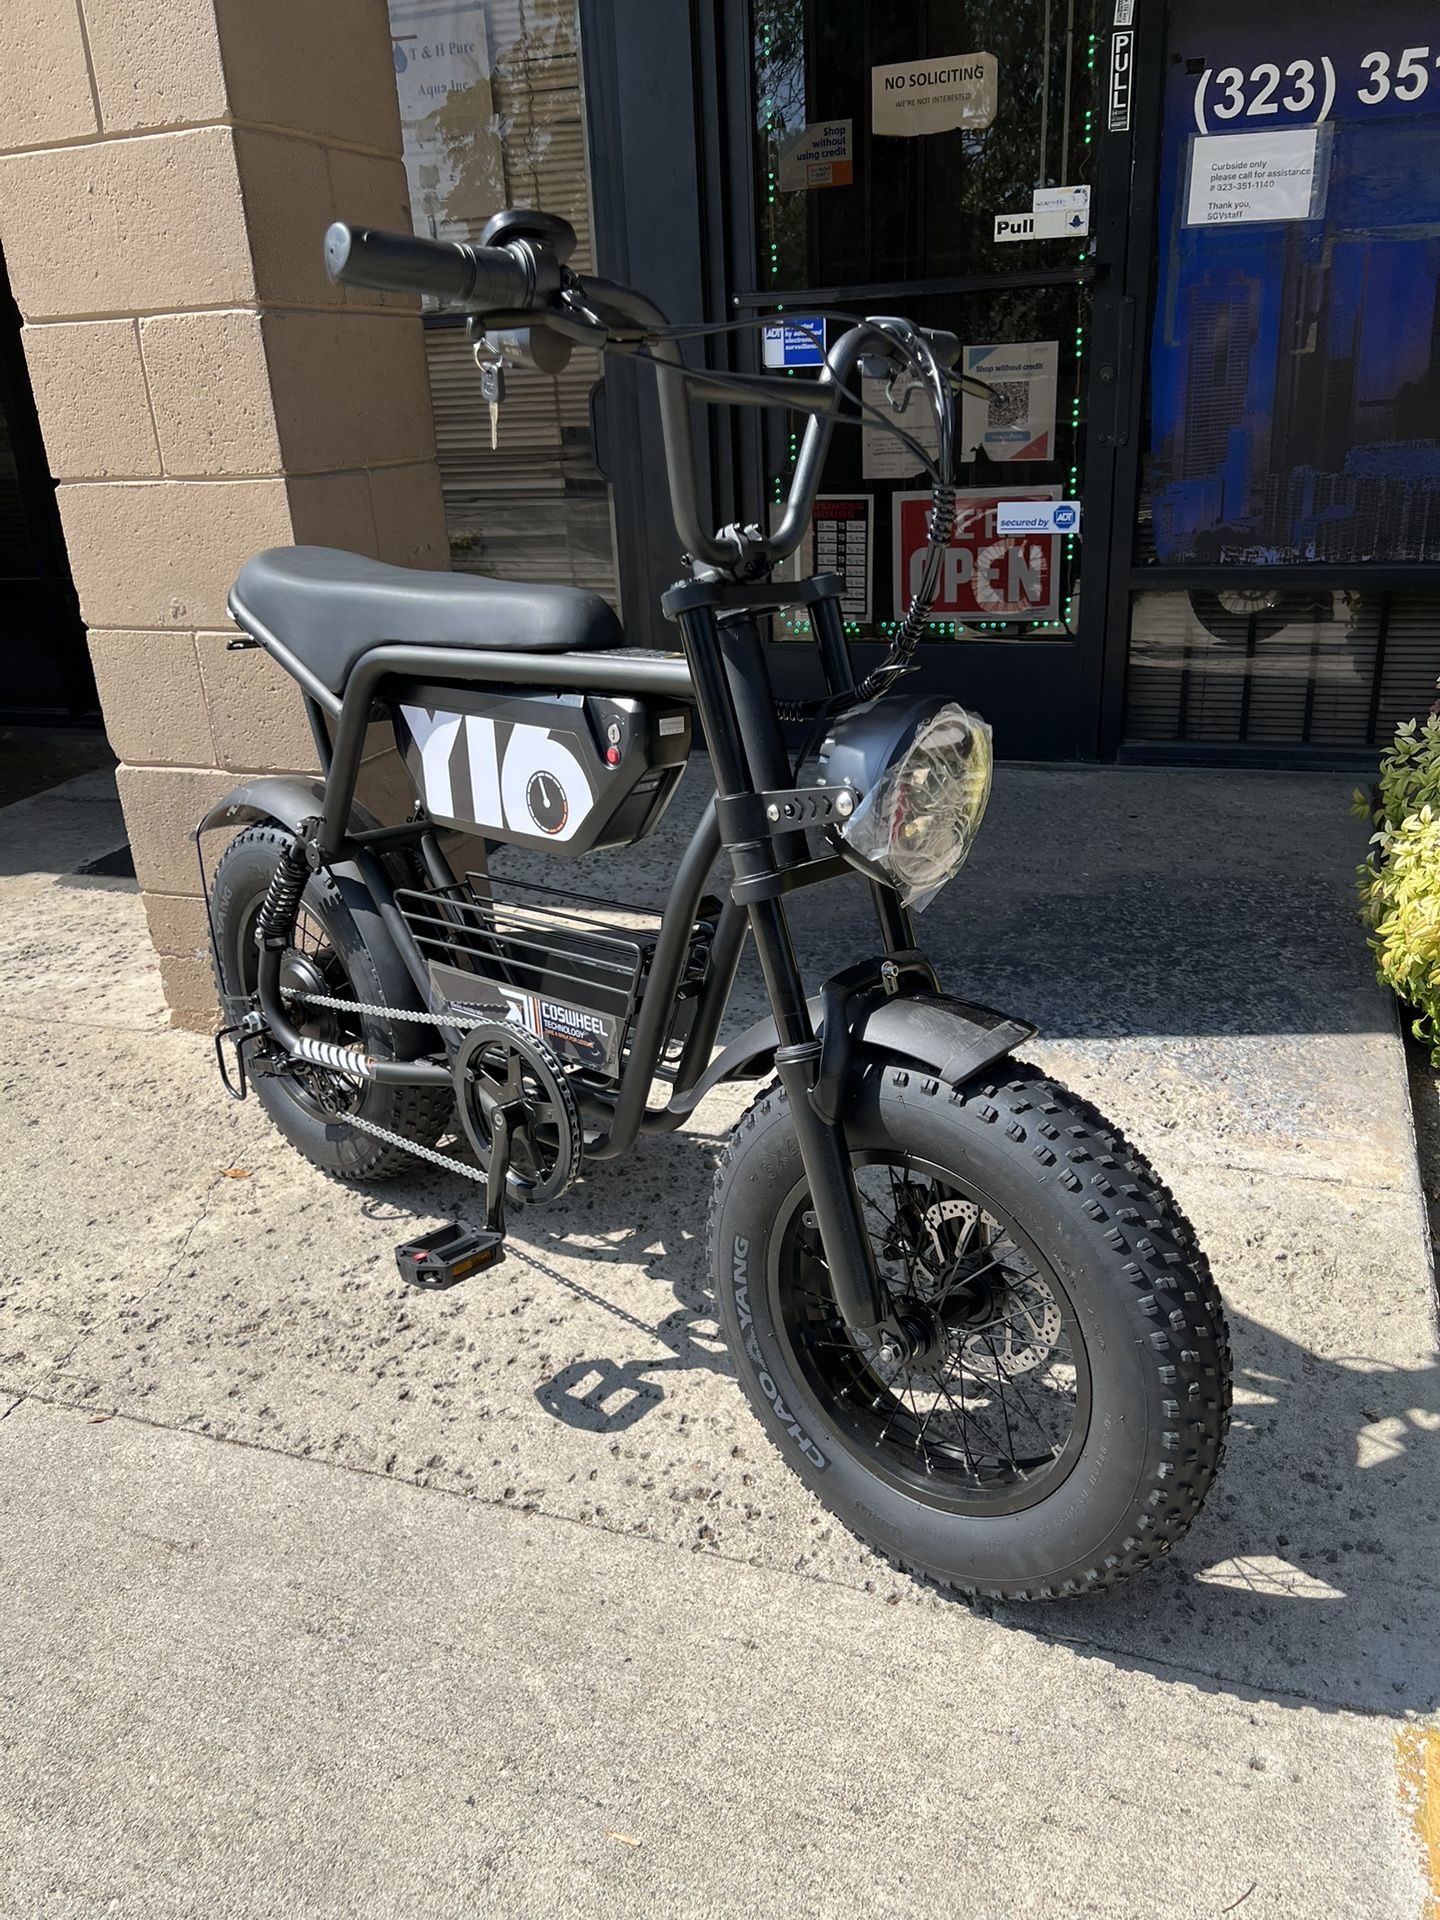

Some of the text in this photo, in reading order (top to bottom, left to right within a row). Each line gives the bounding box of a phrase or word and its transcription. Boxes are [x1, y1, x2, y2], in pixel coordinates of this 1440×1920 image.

[409, 41, 475, 61] T & H Pure
[885, 65, 984, 91] NO SOLICITING
[1113, 35, 1129, 109] PULL
[418, 83, 447, 98] Aqua
[1194, 46, 1440, 134] (323) 35
[917, 97, 931, 105] NOT
[932, 92, 972, 104] INTERESTED
[823, 126, 846, 137] Shop
[812, 137, 846, 148] without
[797, 147, 846, 161] using credit
[1211, 160, 1267, 171] Curbside only
[1210, 168, 1312, 182] please call for assistance
[1217, 180, 1275, 191] 323-351-1140
[1208, 201, 1251, 210] Thank you,
[1207, 211, 1243, 221] SGVstaff
[997, 219, 1034, 235] Pull
[766, 329, 781, 339] ADT
[976, 362, 1043, 373] Shop without credit
[1037, 518, 1049, 528] by
[1056, 512, 1074, 522] ADT
[910, 543, 1042, 604] OPEN
[541, 1001, 609, 1037] COSWHEEL
[543, 1019, 585, 1039] TECHNOLOGY
[733, 1236, 828, 1469] CHAO YANG
